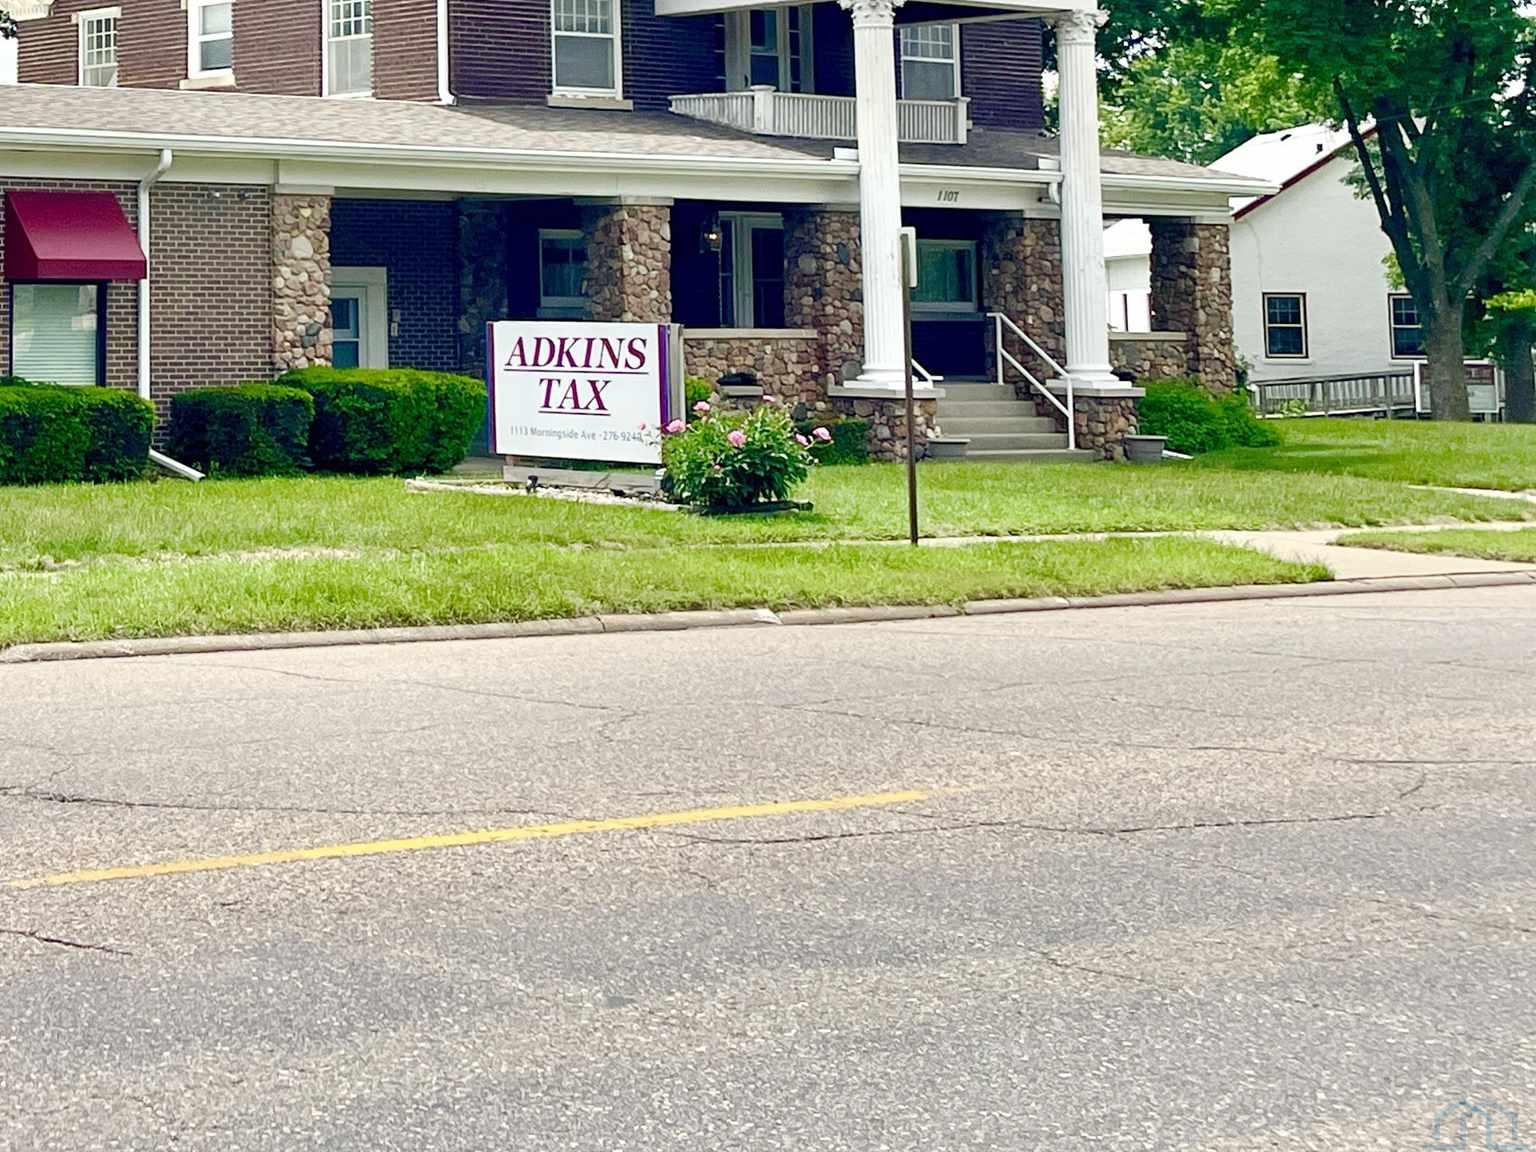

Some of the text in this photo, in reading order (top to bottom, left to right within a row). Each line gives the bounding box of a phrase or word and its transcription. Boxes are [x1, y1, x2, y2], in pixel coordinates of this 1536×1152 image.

[937, 190, 959, 202] 1107
[504, 336, 647, 370] ADKINS
[539, 378, 611, 411] TAX
[580, 430, 596, 440] Ave
